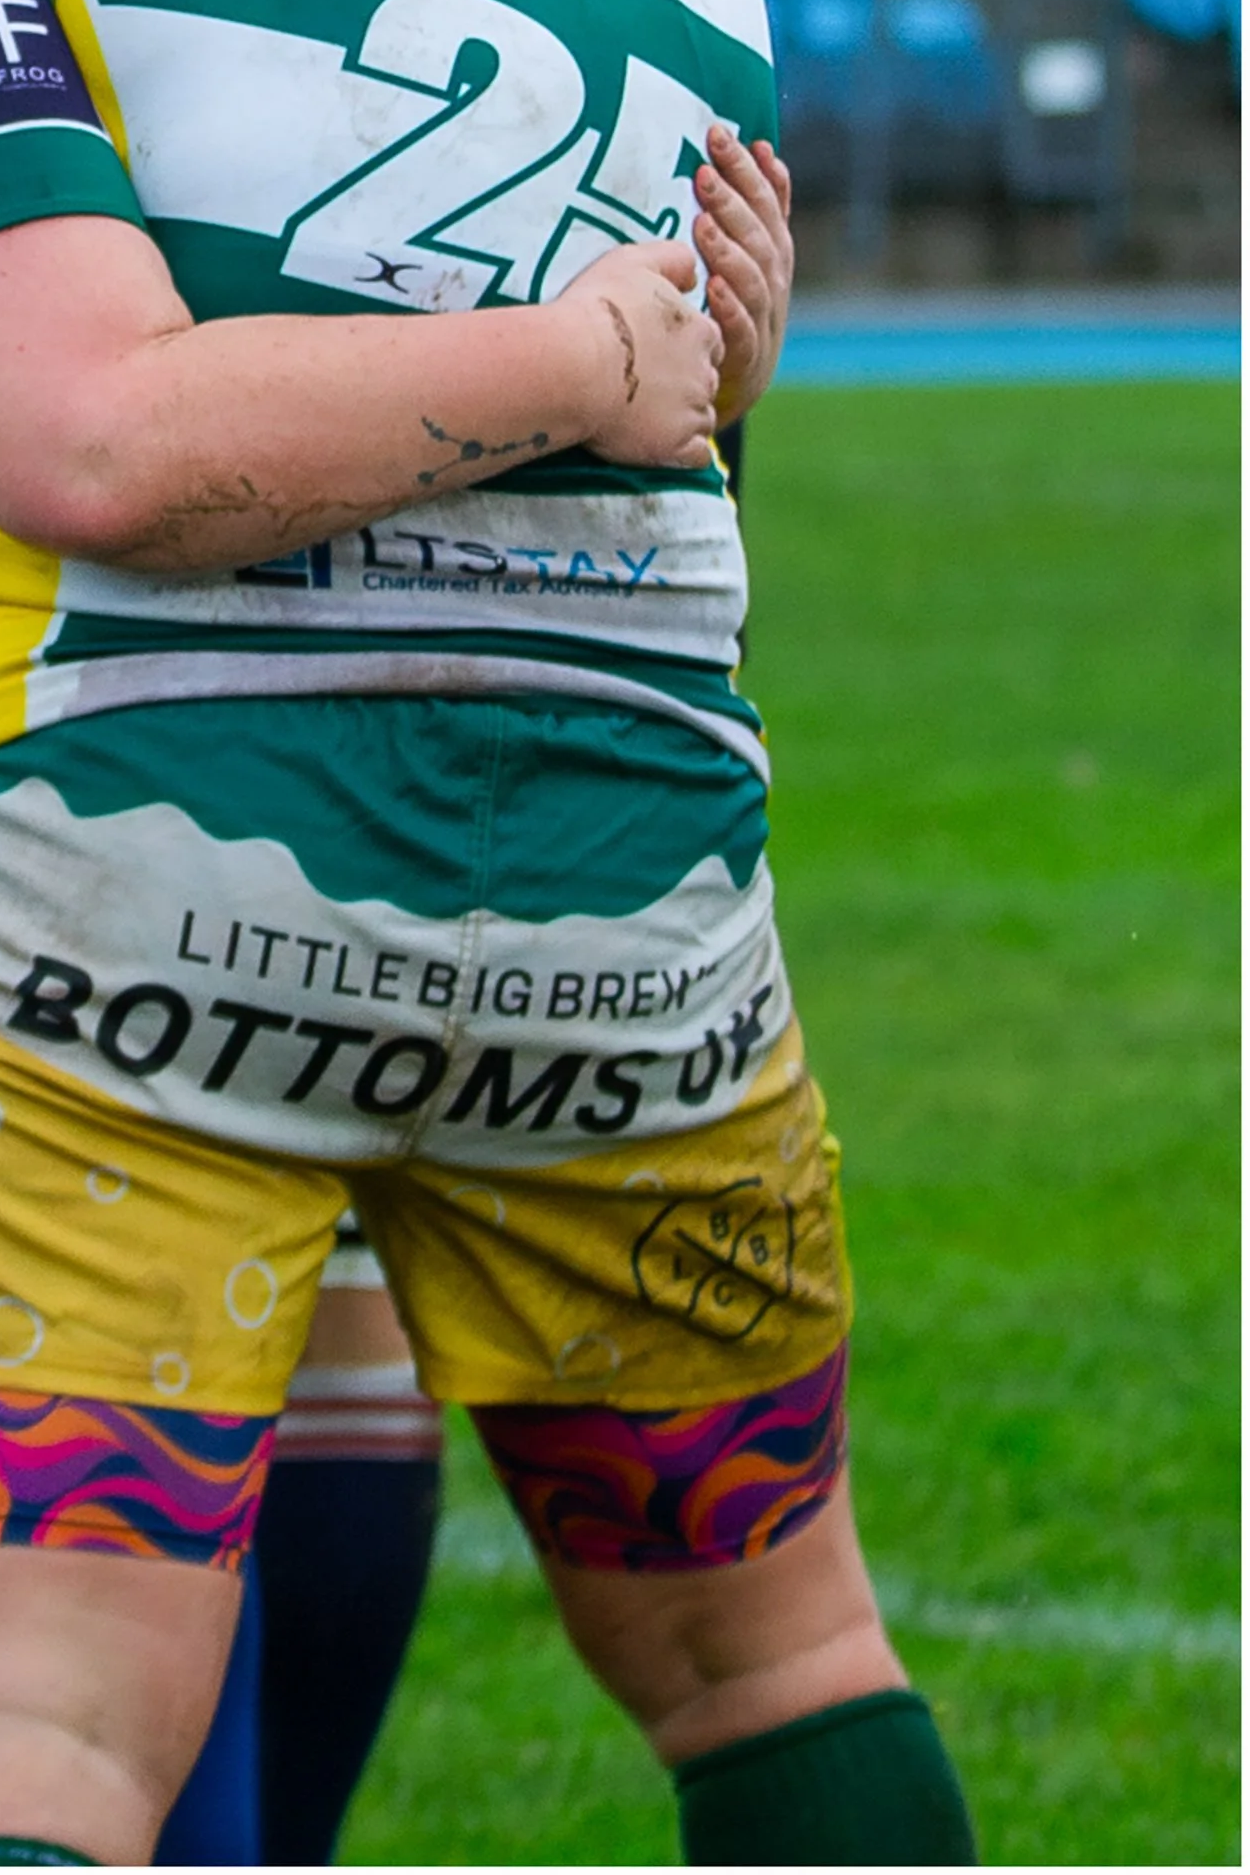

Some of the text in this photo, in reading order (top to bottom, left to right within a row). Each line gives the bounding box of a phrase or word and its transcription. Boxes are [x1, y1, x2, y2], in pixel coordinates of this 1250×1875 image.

[362, 572, 479, 593] Chartered
[491, 578, 534, 595] Tax
[6, 954, 663, 1133] BOTTOMS
